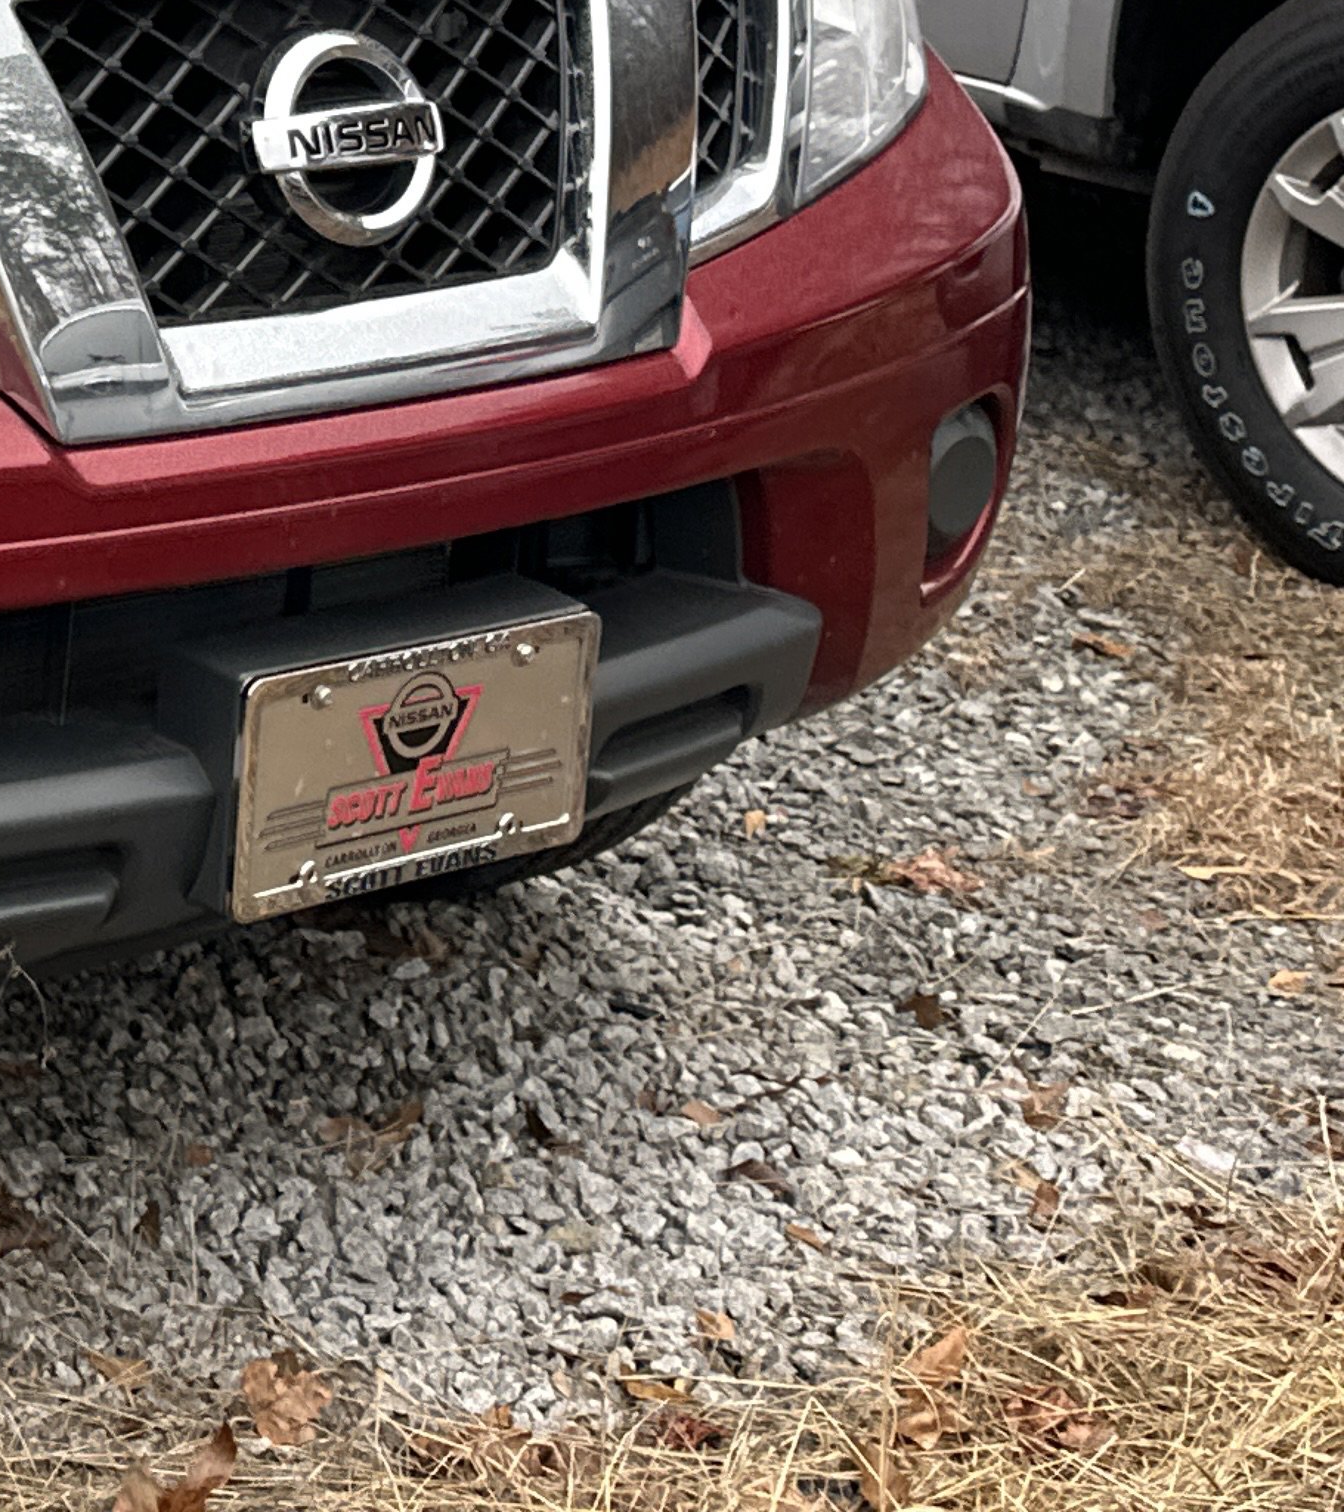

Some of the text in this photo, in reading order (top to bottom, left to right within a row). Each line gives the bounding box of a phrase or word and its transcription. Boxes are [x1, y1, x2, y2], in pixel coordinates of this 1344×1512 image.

[286, 115, 437, 160] NISSAN
[387, 703, 454, 730] NISSAN
[328, 782, 408, 829] SCOTT
[427, 823, 478, 843] GEORGIA
[325, 842, 398, 868] CARROLLTON
[325, 845, 498, 899] SCOTT EVANS
